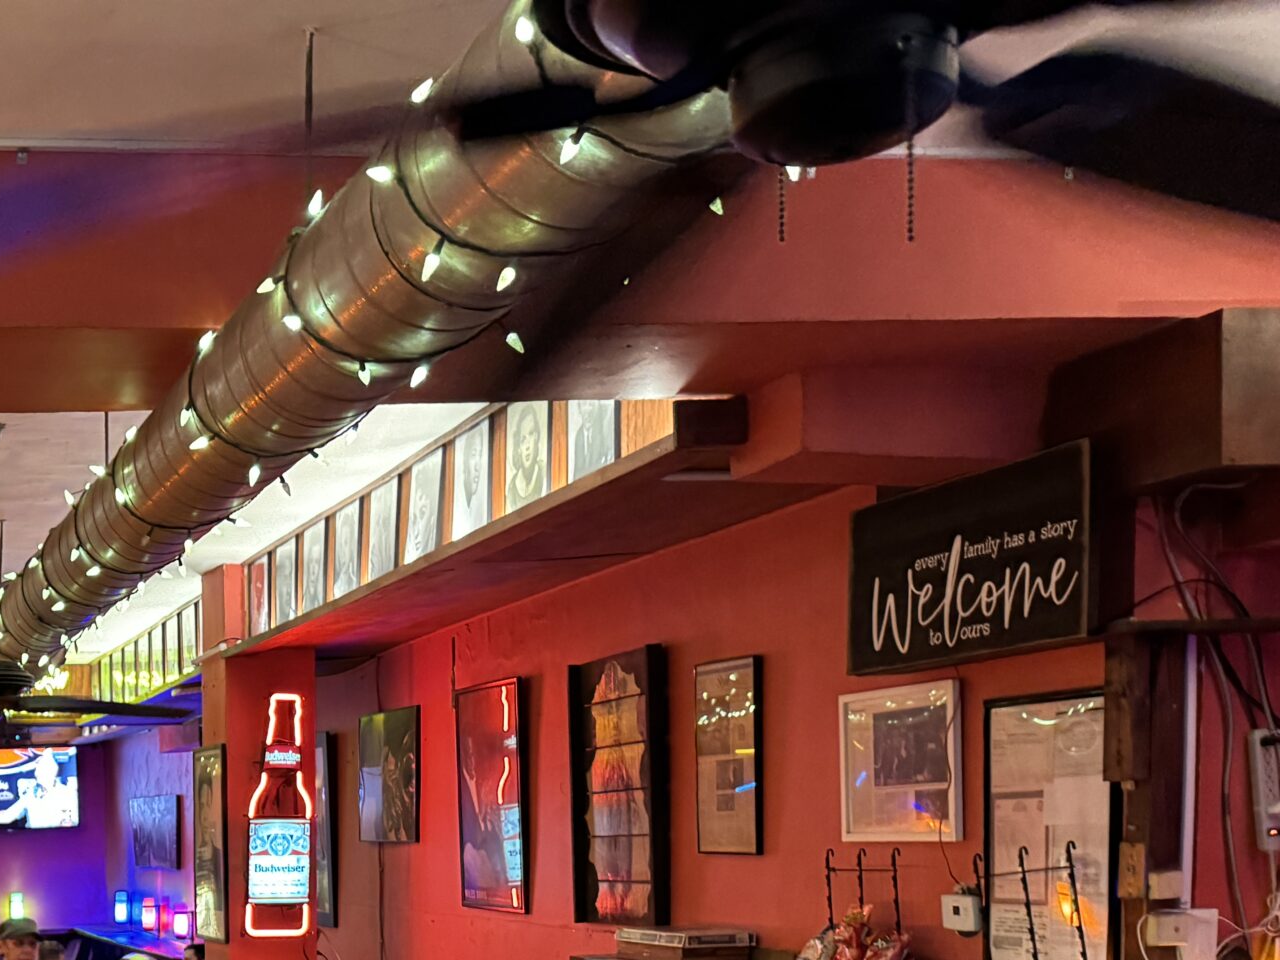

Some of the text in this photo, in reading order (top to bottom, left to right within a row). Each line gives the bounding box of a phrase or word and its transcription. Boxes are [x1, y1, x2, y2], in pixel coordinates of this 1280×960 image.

[914, 518, 1078, 572] every family has a story
[871, 534, 1079, 655] Welcome
[929, 621, 991, 646] to ours
[254, 863, 306, 873] Budweiser
